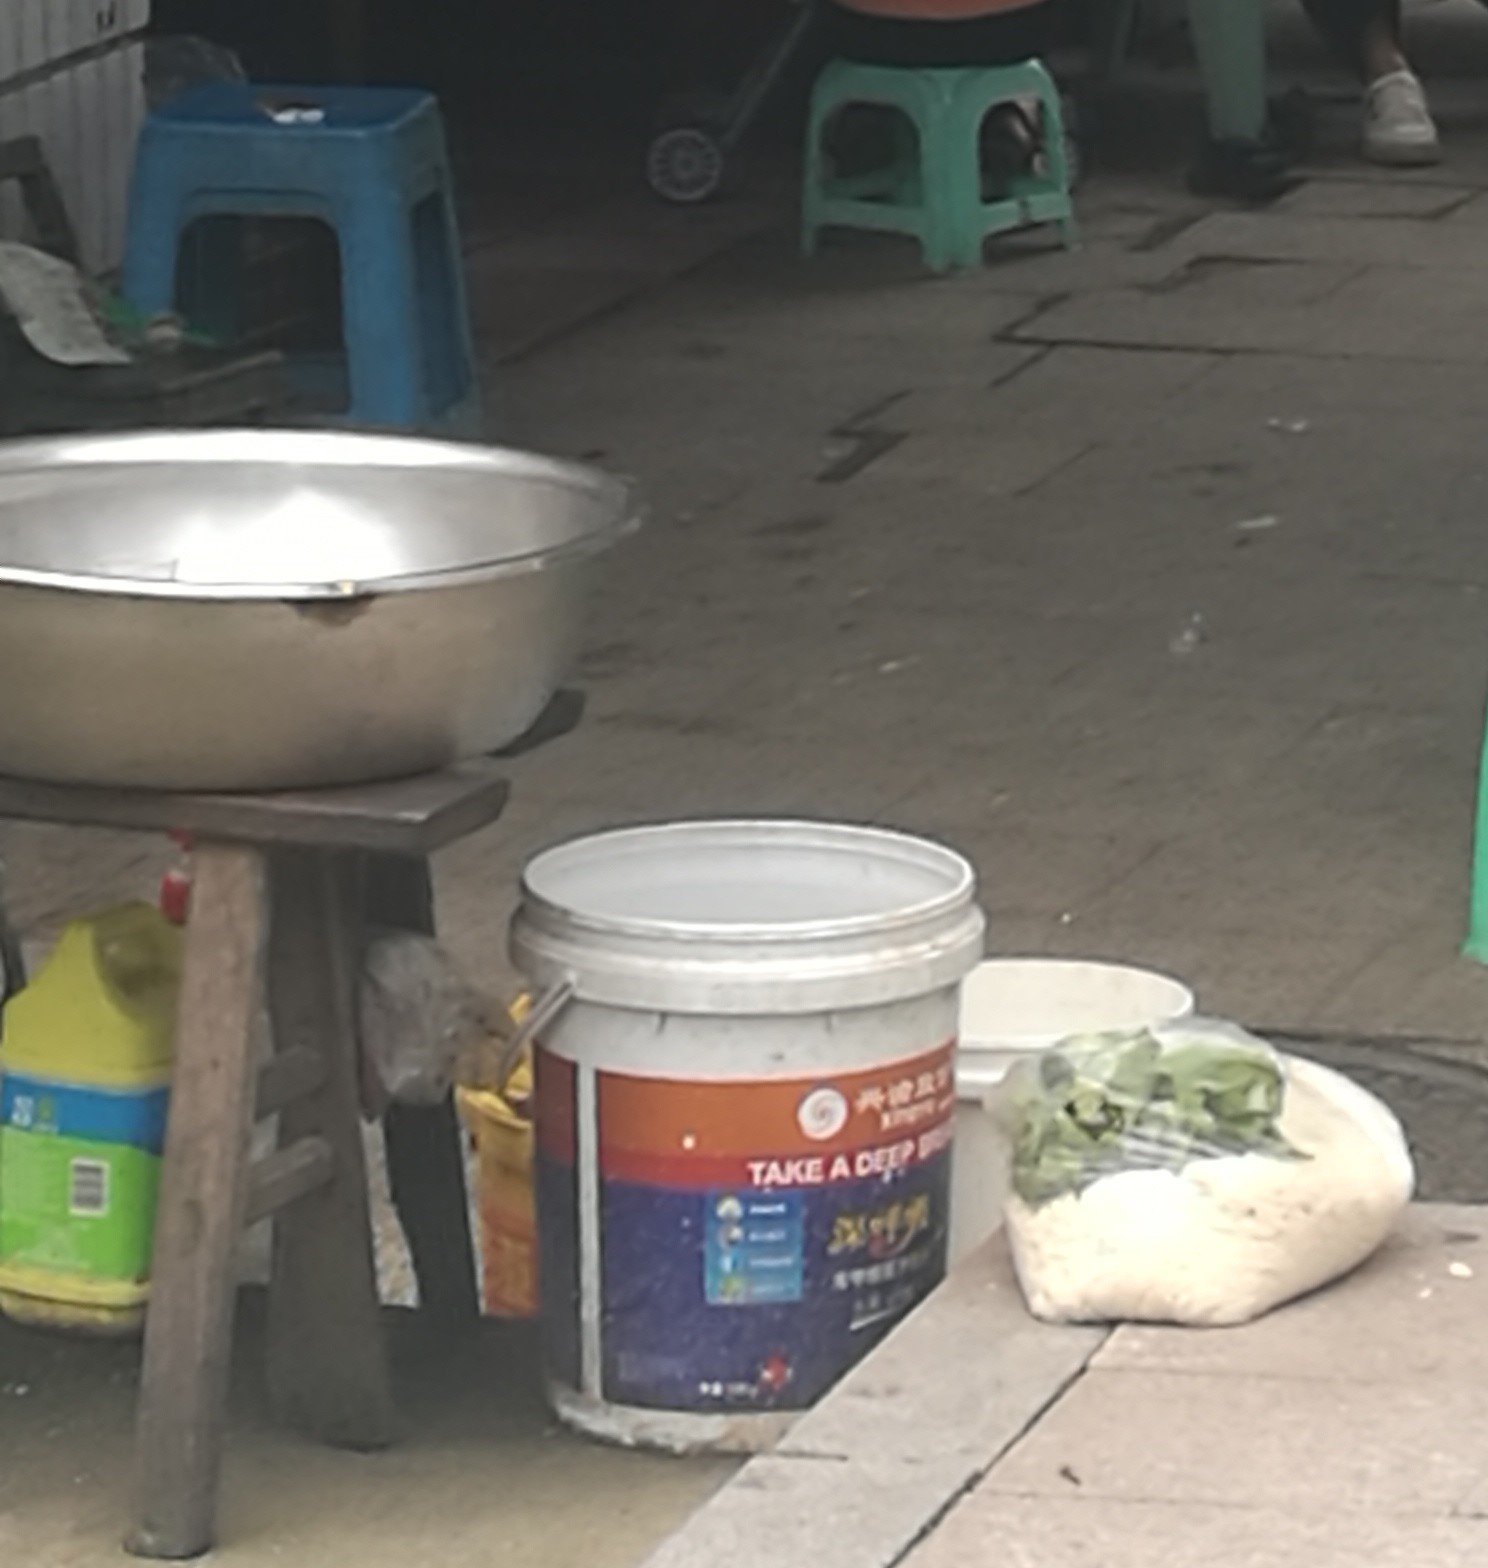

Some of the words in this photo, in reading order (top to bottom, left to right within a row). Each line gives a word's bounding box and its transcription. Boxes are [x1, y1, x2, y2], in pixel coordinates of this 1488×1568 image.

[747, 1157, 824, 1186] TAKE
[828, 1155, 850, 1180] A
[855, 1141, 914, 1176] DEEP
